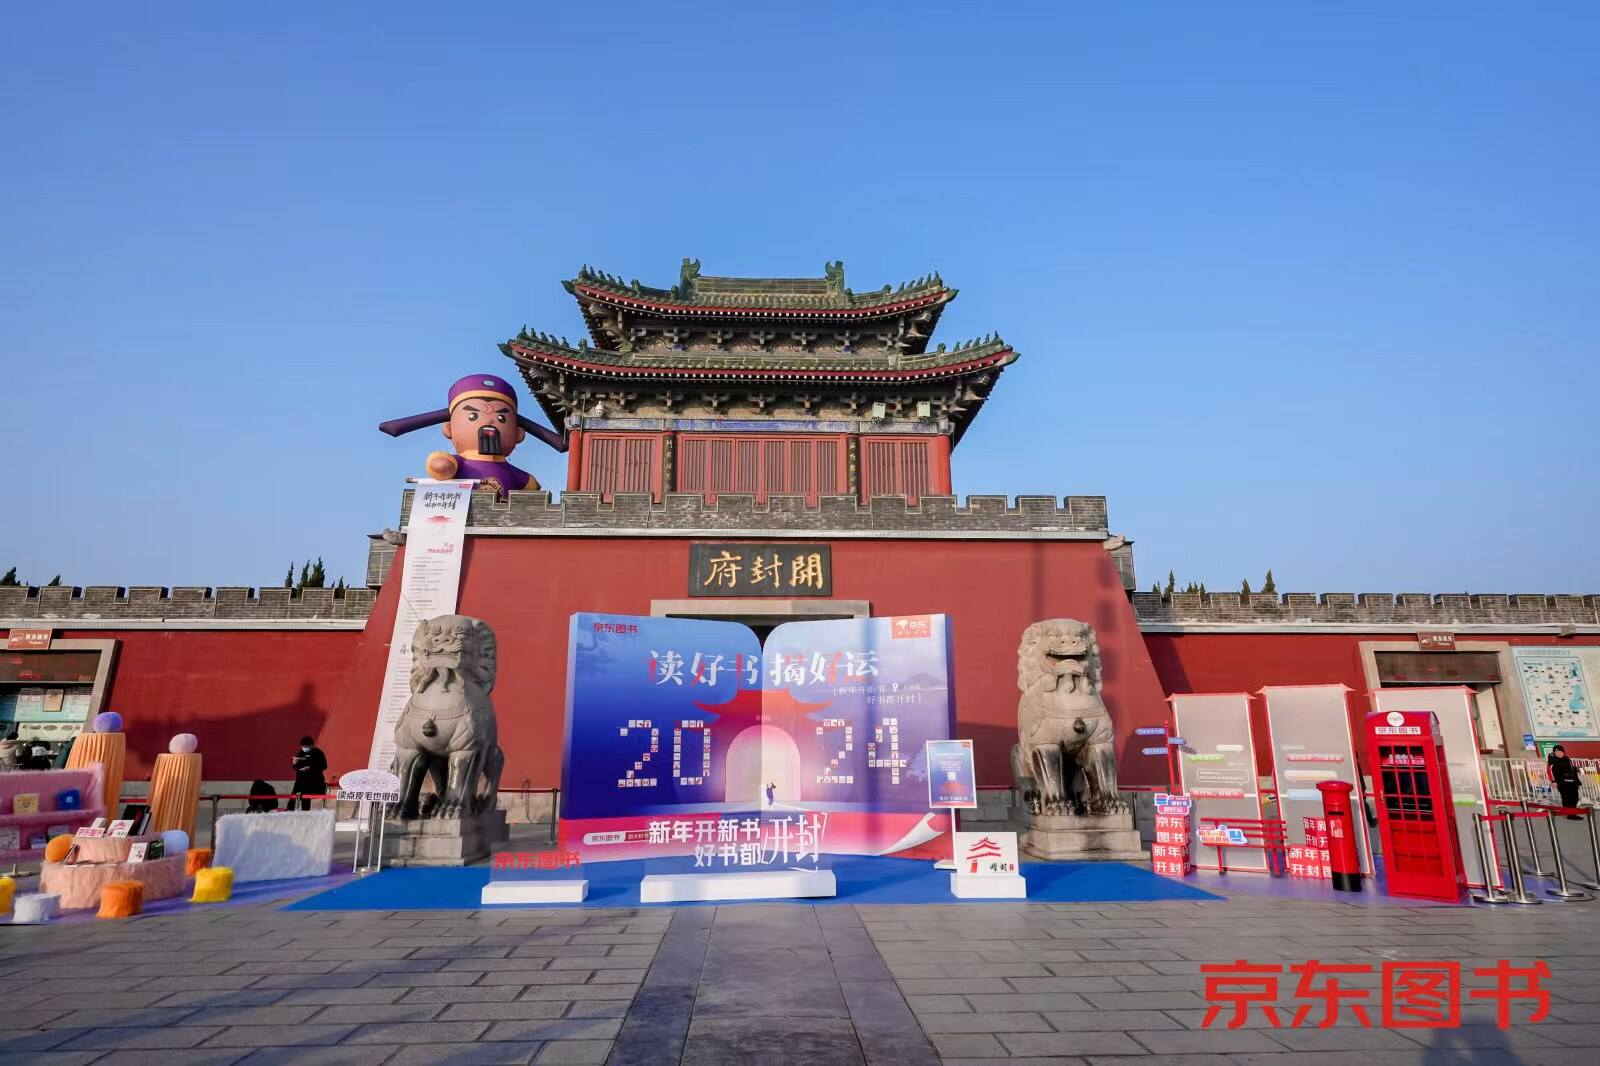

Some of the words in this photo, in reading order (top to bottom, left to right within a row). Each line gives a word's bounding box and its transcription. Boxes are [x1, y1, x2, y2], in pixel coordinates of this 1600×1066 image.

[593, 623, 637, 633] 京东图书
[648, 650, 759, 690] 读好书
[769, 651, 879, 686] 揭好运
[337, 791, 399, 801] 读点皮毛也很值
[1156, 816, 1184, 828] 京东
[648, 818, 761, 844] 新年开新书
[1156, 832, 1184, 843] 图书
[1154, 845, 1181, 857] 新年
[1289, 848, 1318, 860] 新年
[1156, 861, 1182, 873] 开封
[1291, 863, 1320, 876] 开封
